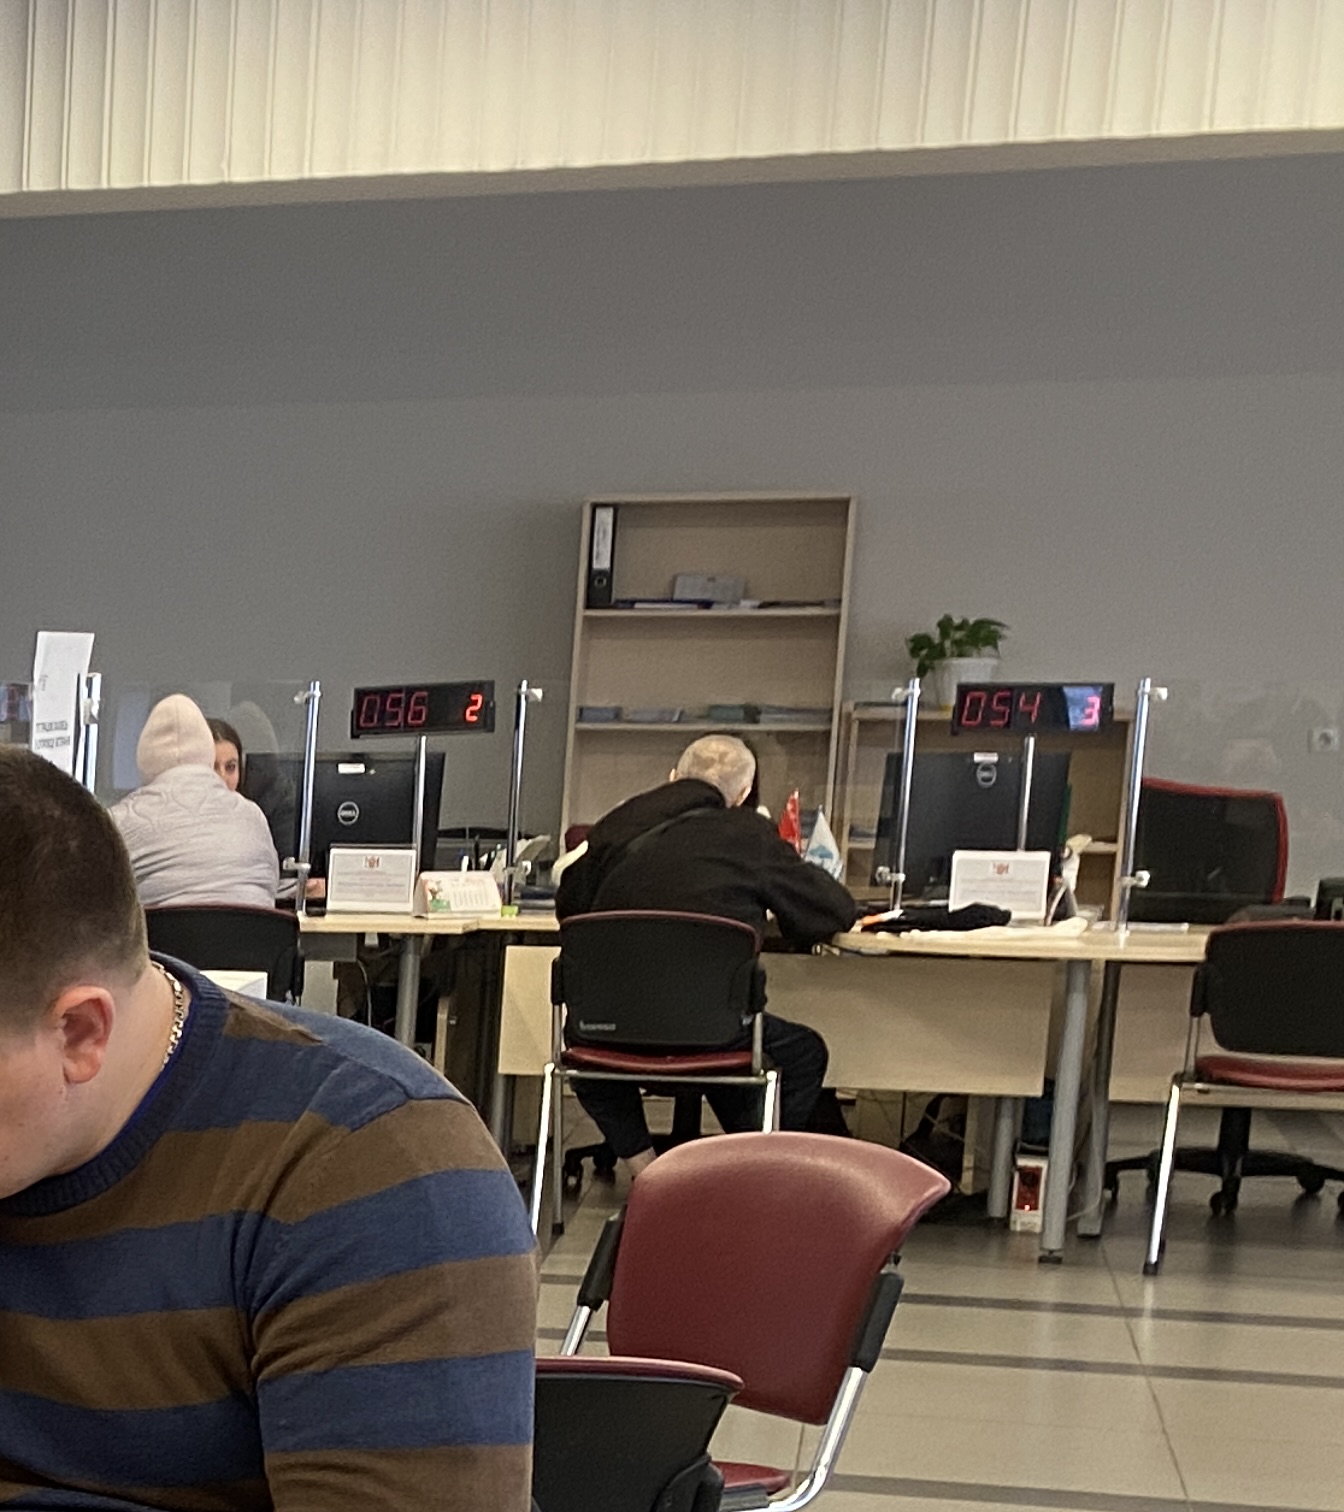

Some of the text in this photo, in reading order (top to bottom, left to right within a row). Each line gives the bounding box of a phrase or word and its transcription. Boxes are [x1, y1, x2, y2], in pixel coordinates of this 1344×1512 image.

[359, 691, 483, 728] 056 2
[961, 691, 1101, 727] 054 3
